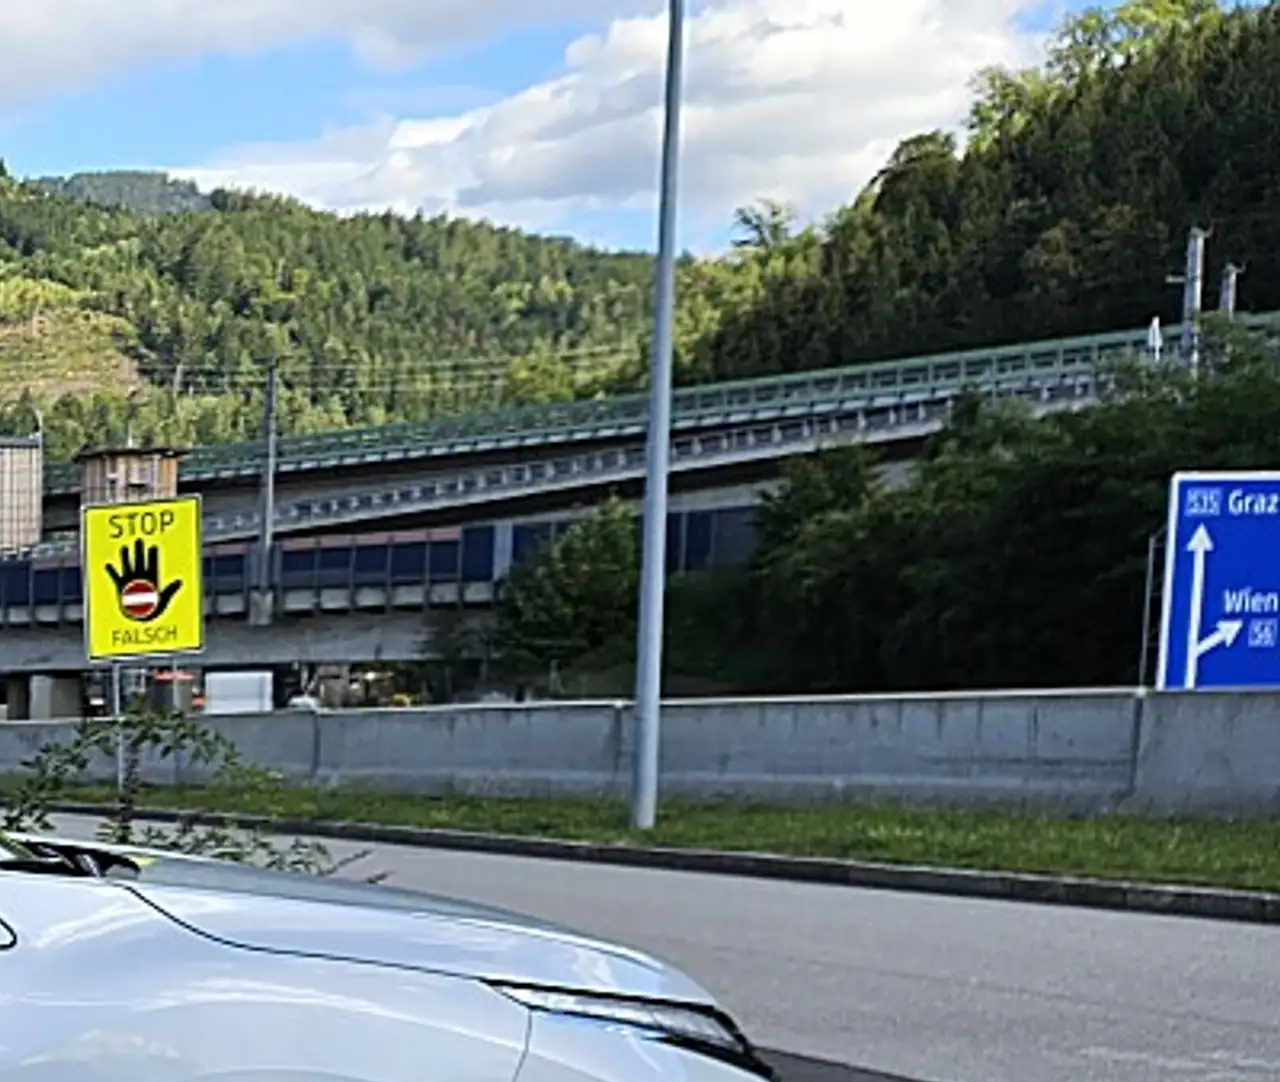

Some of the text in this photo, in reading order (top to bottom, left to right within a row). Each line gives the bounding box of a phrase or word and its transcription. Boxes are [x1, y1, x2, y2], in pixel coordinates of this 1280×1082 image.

[1228, 489, 1279, 516] Graz
[108, 510, 174, 539] STOP
[1224, 586, 1279, 614] Wien
[111, 625, 178, 647] FALSCH
